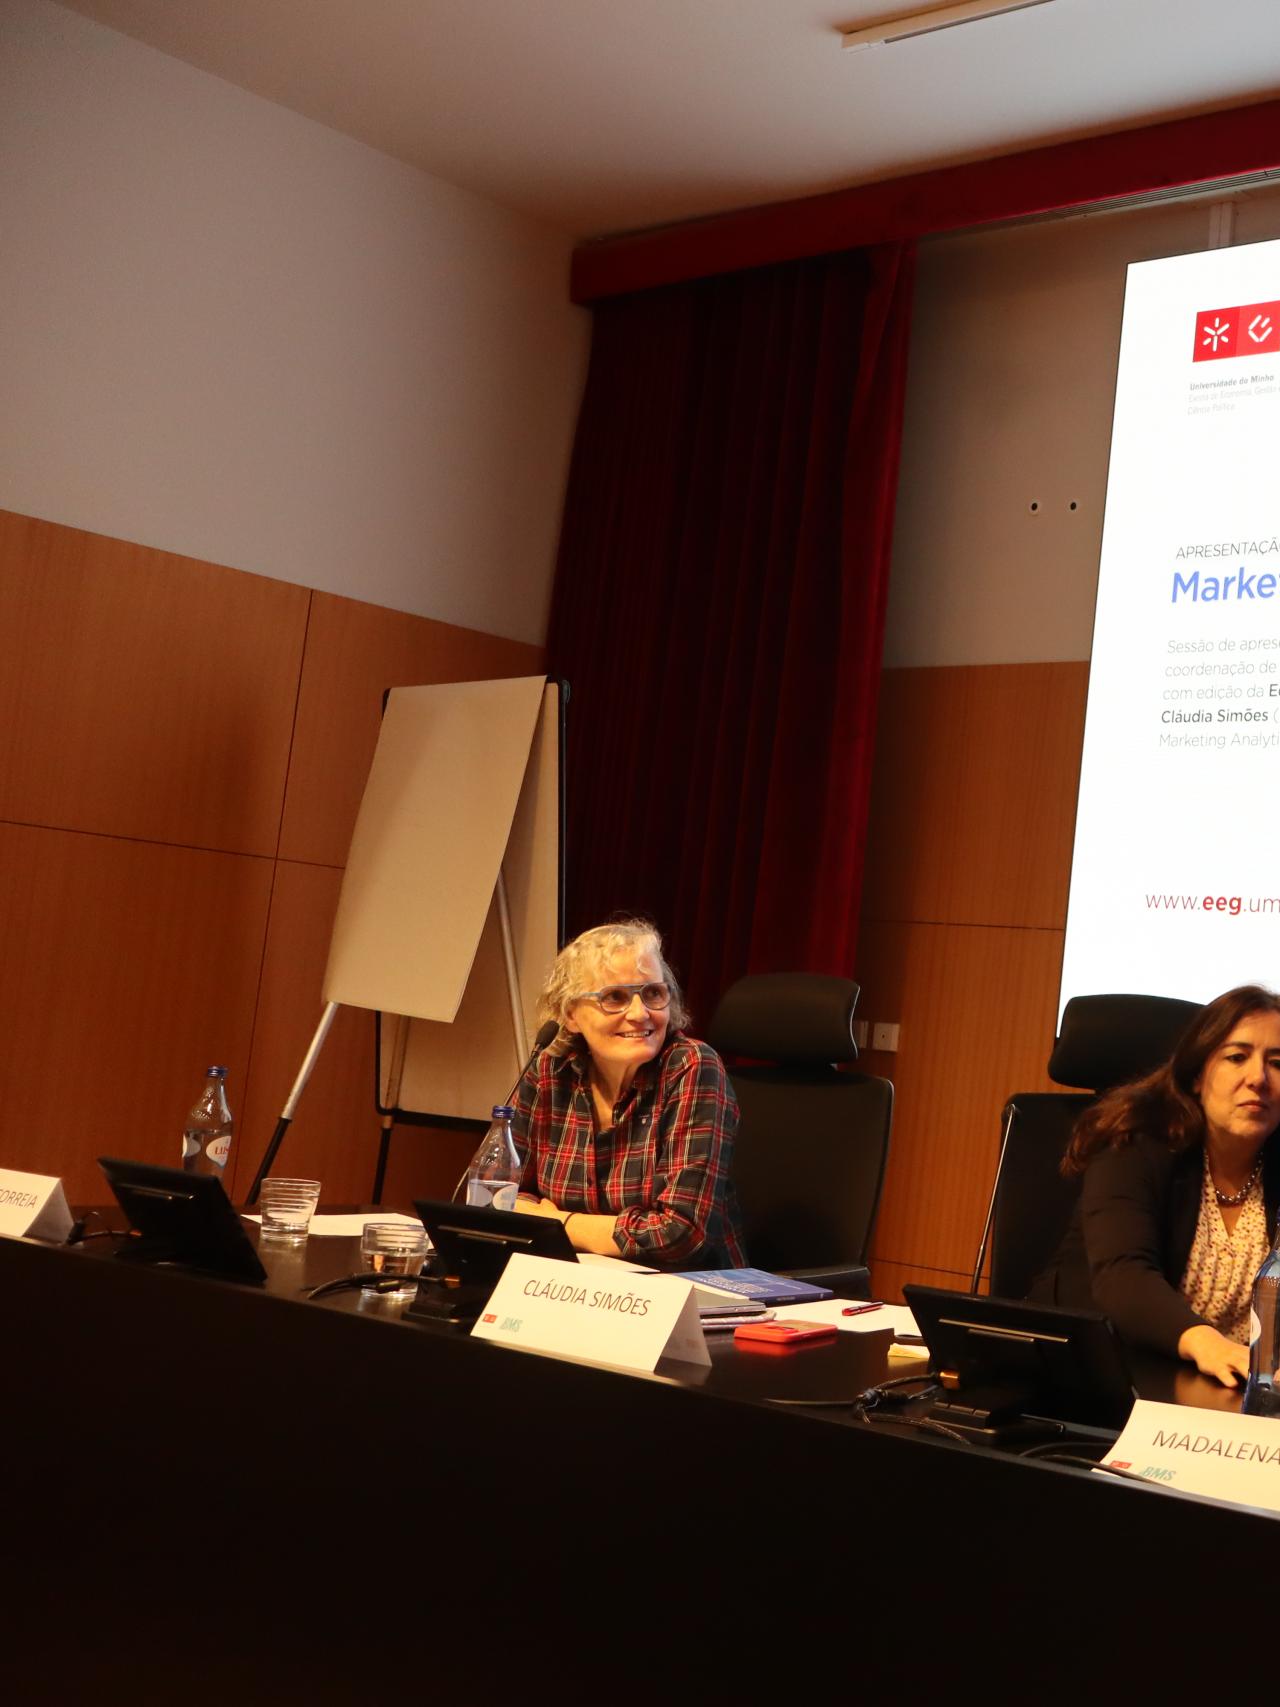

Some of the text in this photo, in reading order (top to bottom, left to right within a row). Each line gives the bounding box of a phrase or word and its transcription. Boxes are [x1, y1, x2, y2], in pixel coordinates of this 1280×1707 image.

[1190, 374, 1275, 391] Universidade do Minho
[1168, 639, 1214, 653] Sessão
[1218, 637, 1236, 651] de
[1165, 661, 1254, 677] coordenação
[1259, 659, 1277, 673] de
[1163, 688, 1192, 700] com
[1196, 685, 1242, 700] edição
[1247, 685, 1264, 698] da
[1161, 709, 1212, 724] Cláudia
[1217, 708, 1268, 723] Simões
[1159, 733, 1226, 749] Marketing
[523, 1278, 652, 1317] CLÁUDIA SIMÕES
